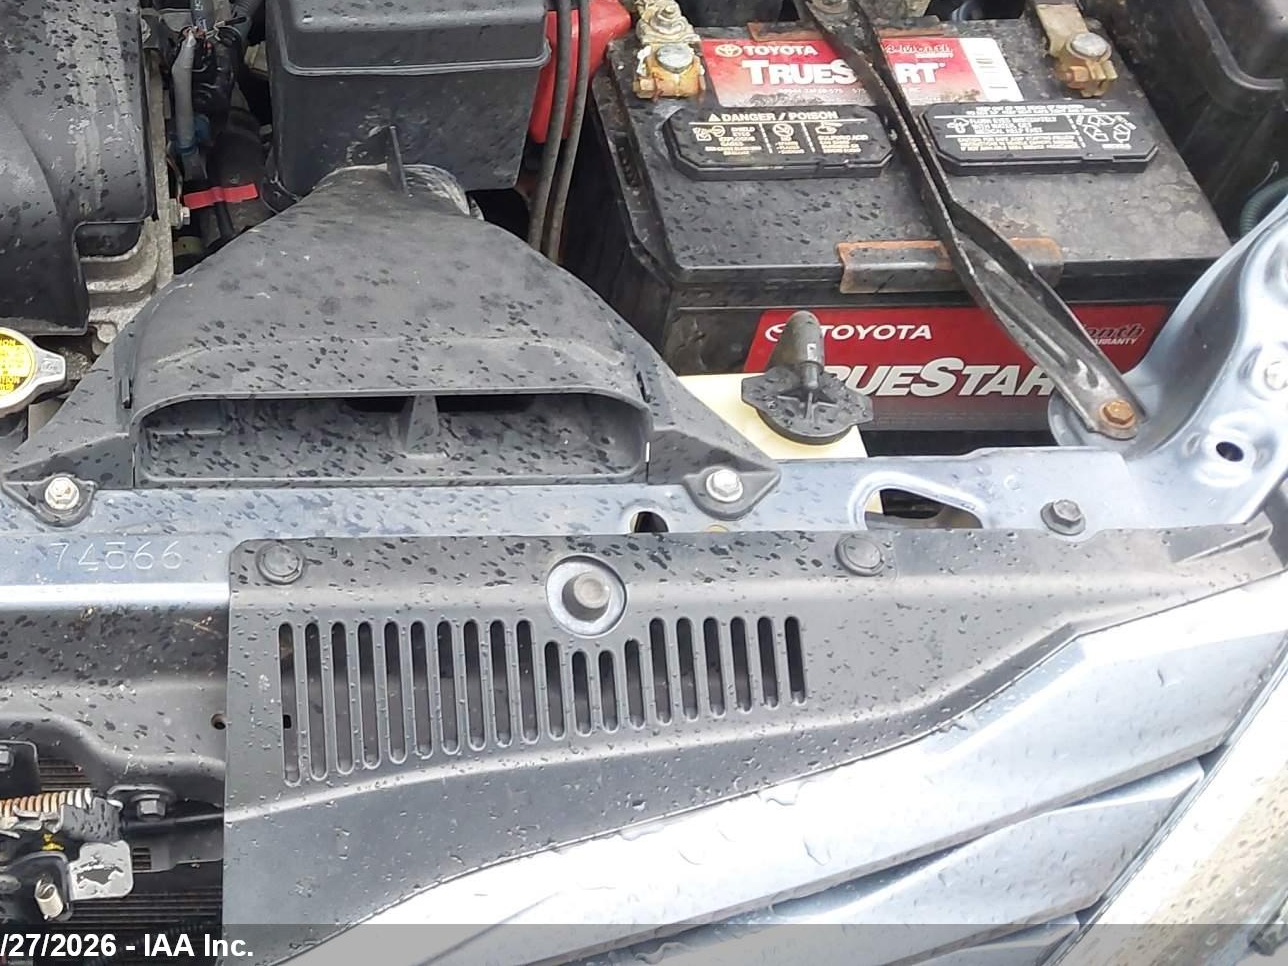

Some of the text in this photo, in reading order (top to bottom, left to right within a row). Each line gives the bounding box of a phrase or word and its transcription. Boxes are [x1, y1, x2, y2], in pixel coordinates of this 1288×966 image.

[743, 45, 819, 56] TOYOTA
[741, 59, 940, 85] TRUESRT
[721, 112, 777, 122] DANGER
[788, 111, 839, 121] POISON
[823, 324, 933, 340] TOYOTA
